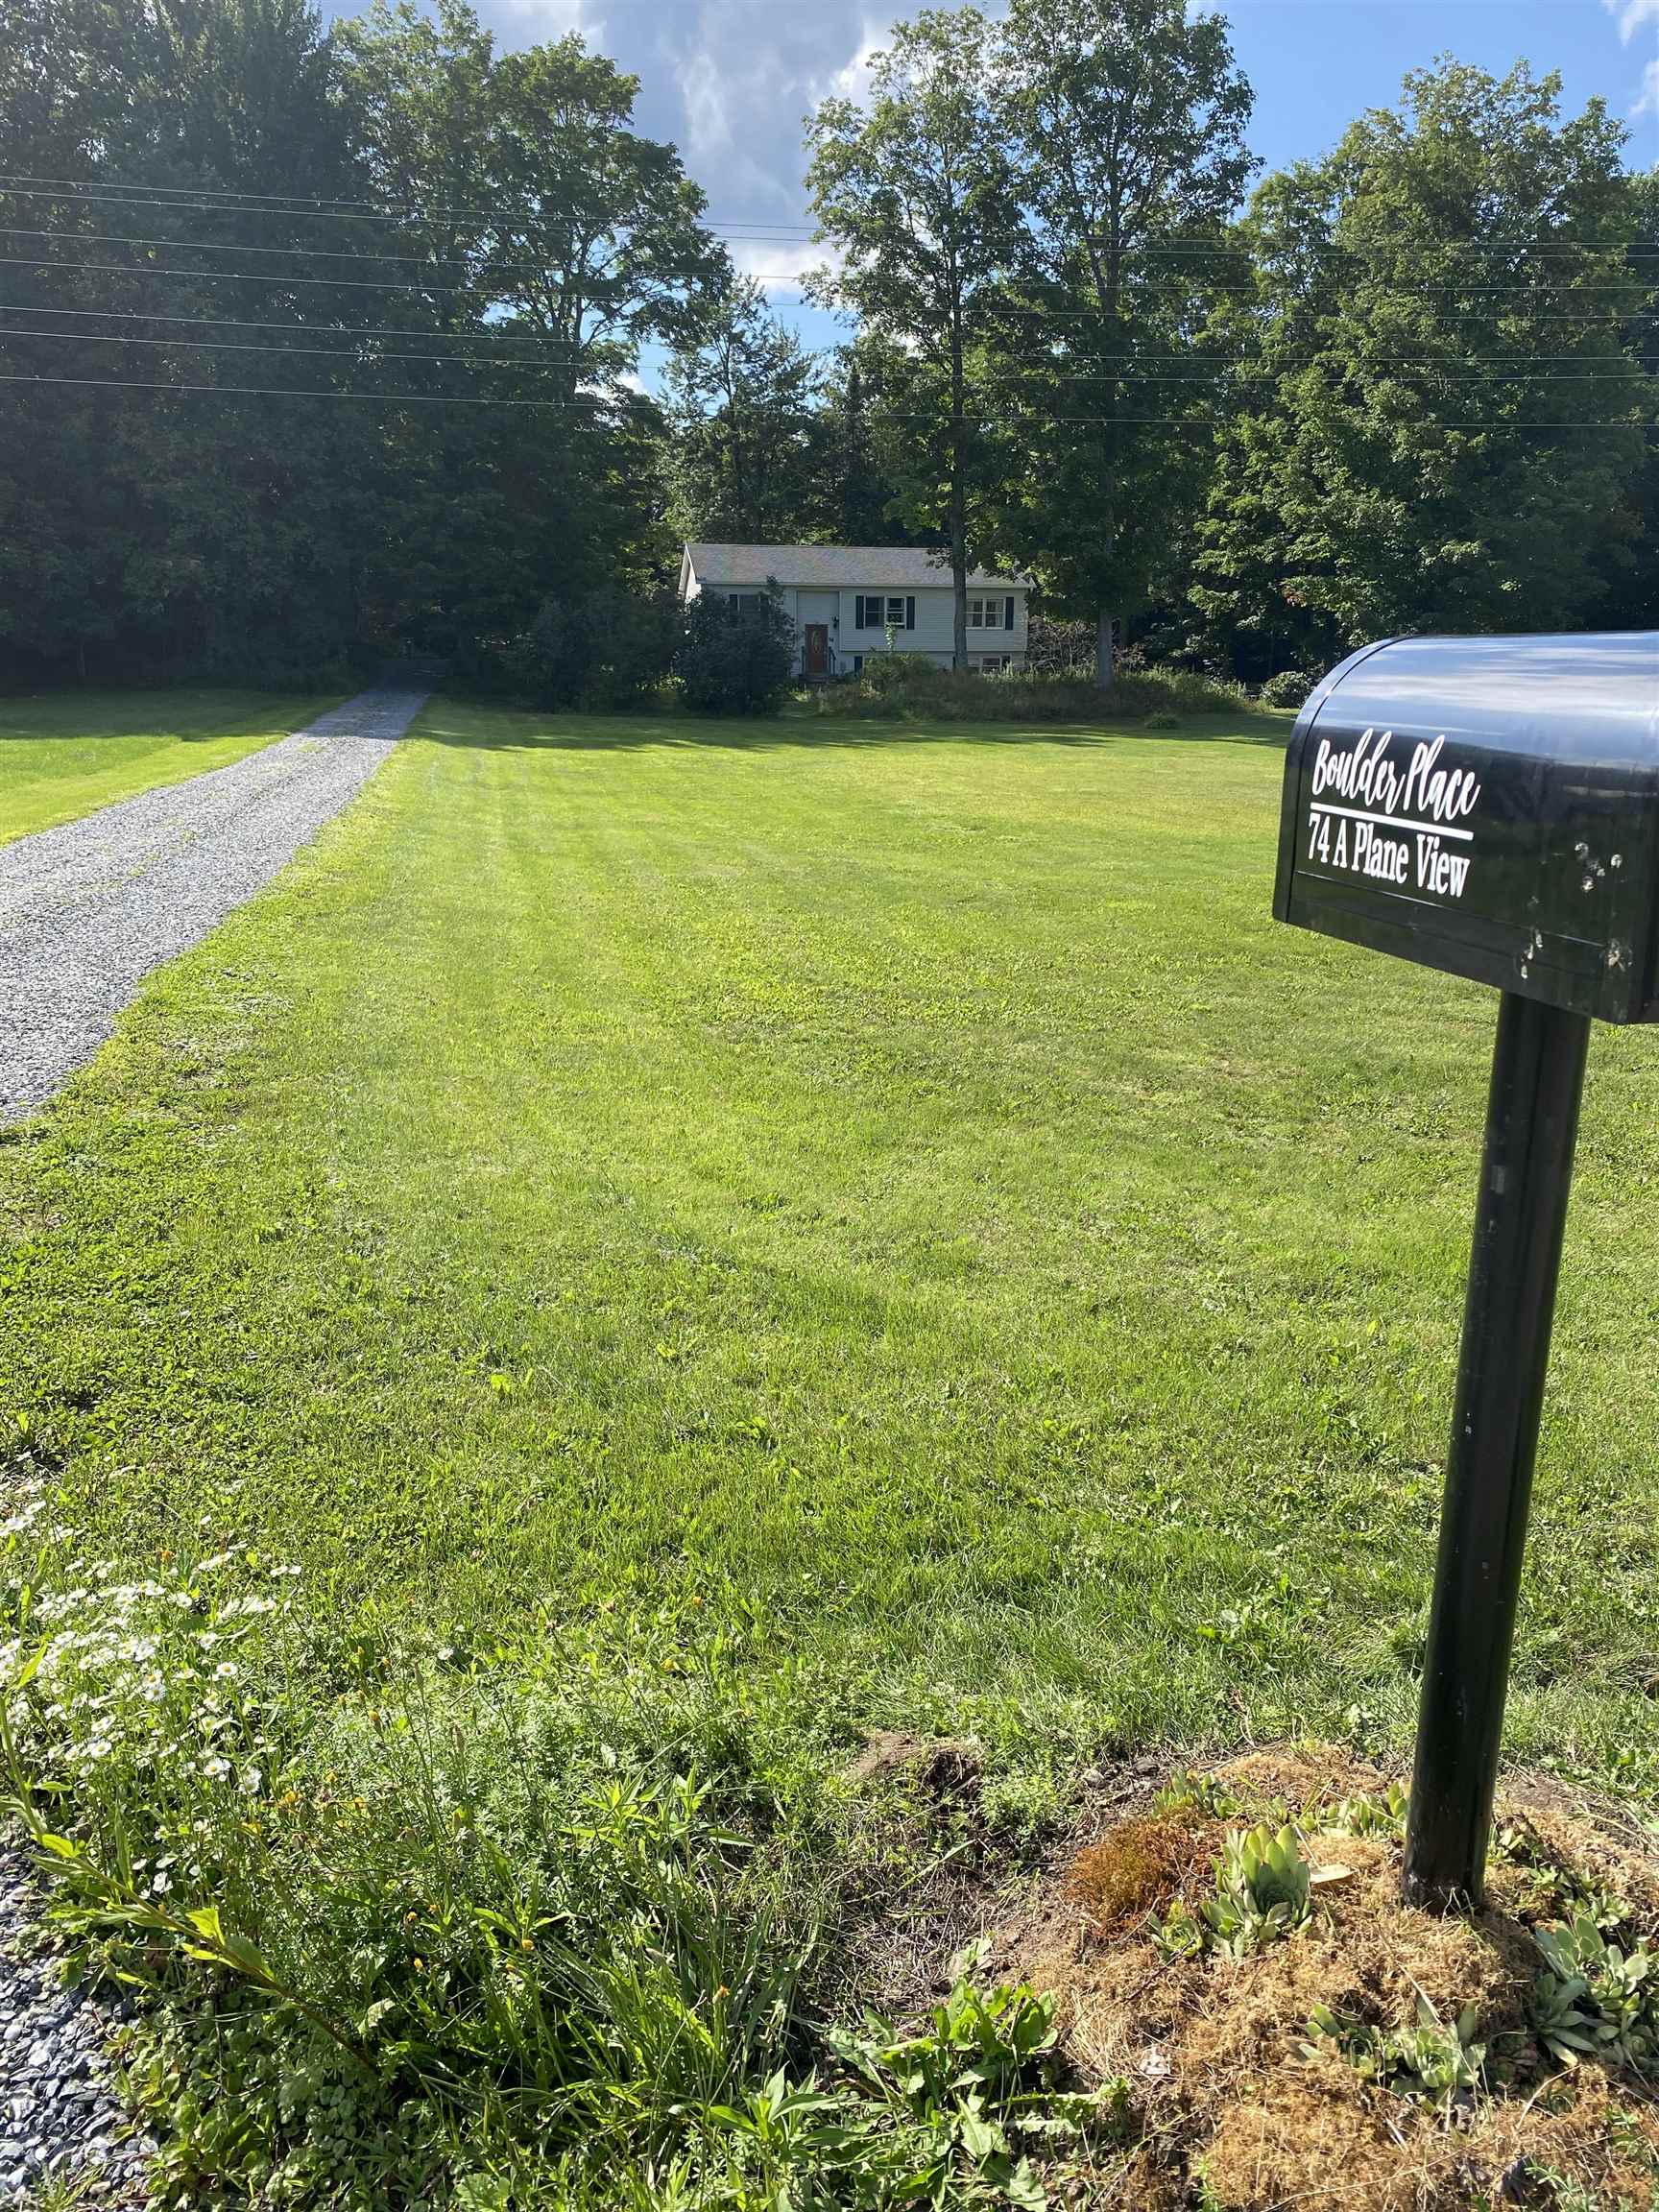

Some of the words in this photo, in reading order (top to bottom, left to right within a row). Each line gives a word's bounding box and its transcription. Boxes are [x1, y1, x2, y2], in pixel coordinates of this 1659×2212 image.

[1311, 728, 1406, 814] Boulder
[1403, 734, 1481, 821] Place
[1308, 812, 1330, 863] 74
[1333, 818, 1348, 869] A
[1351, 821, 1409, 884] Plane
[1415, 832, 1471, 898] View
